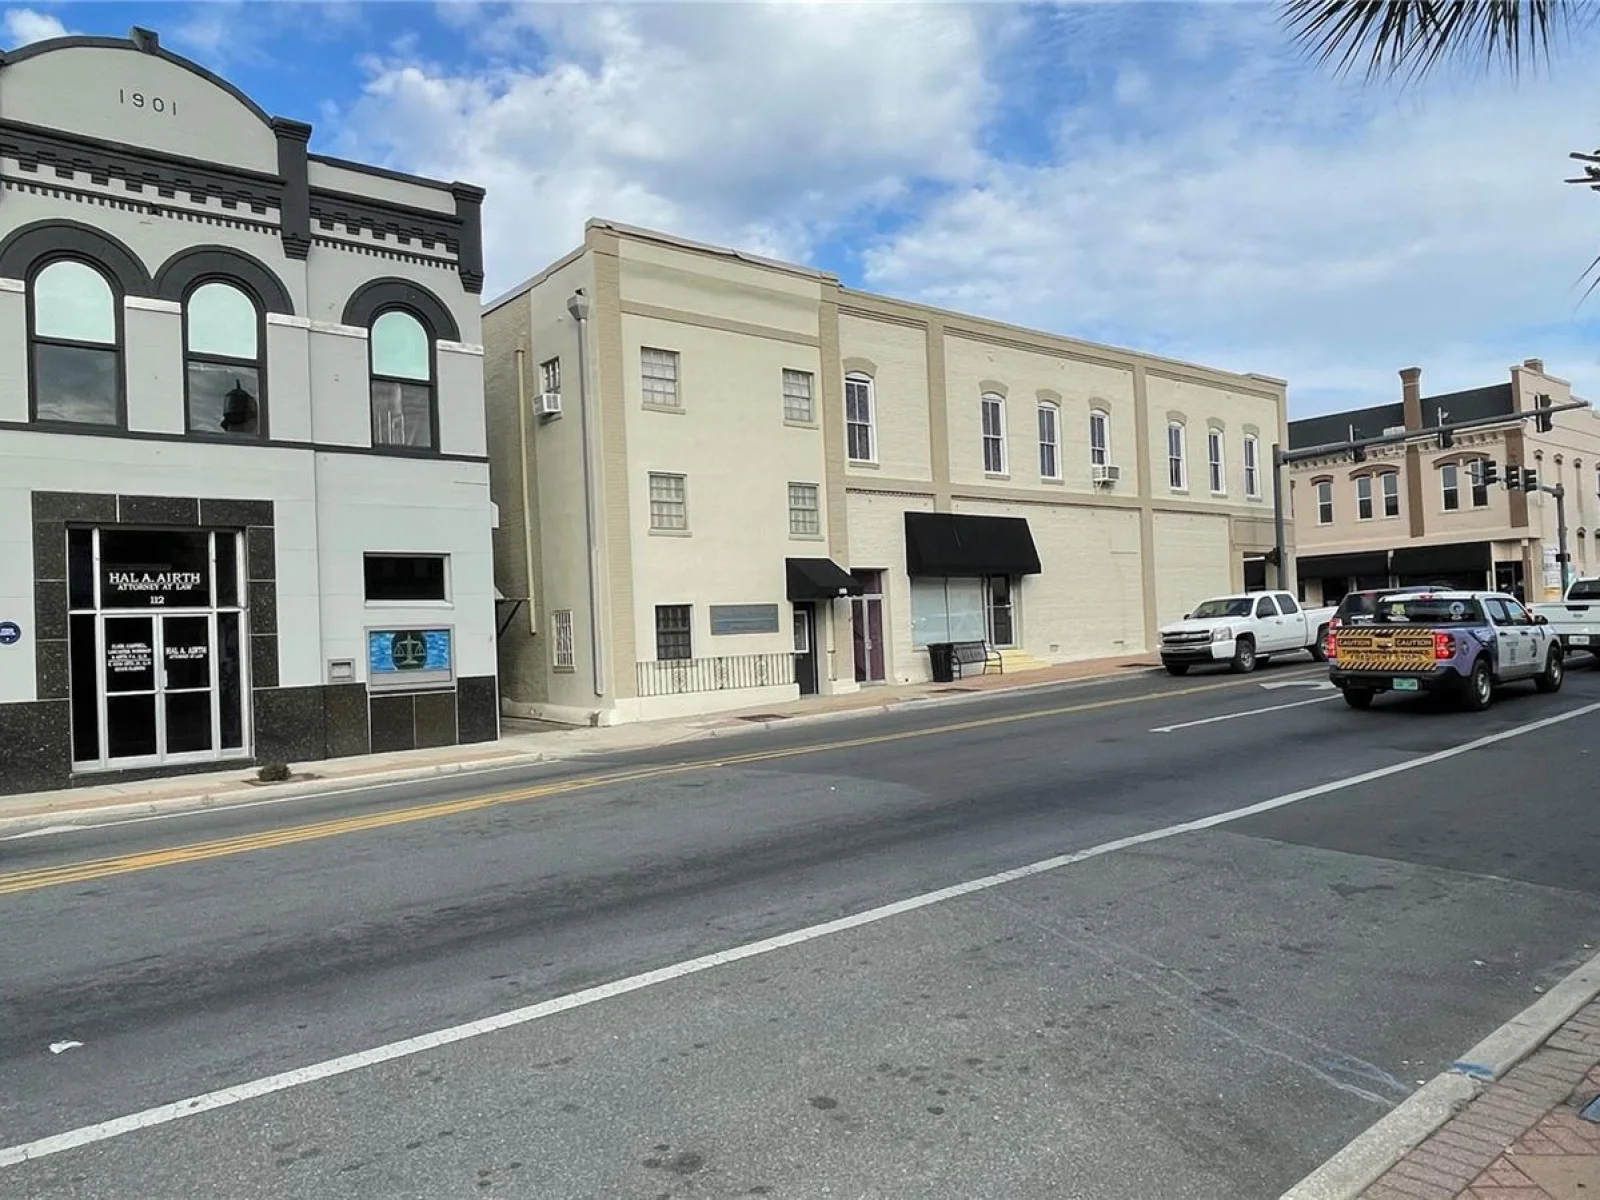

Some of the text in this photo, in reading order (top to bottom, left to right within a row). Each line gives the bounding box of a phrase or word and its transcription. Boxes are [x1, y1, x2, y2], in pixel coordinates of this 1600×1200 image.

[120, 89, 176, 116] 1901
[109, 572, 139, 584] HAL
[157, 572, 200, 584] AIRTH
[117, 583, 160, 591] ATTORNEY
[176, 583, 193, 591] LAW
[150, 596, 165, 604] 112
[1340, 638, 1371, 646] CAUTION
[1397, 638, 1432, 646] CAUTION
